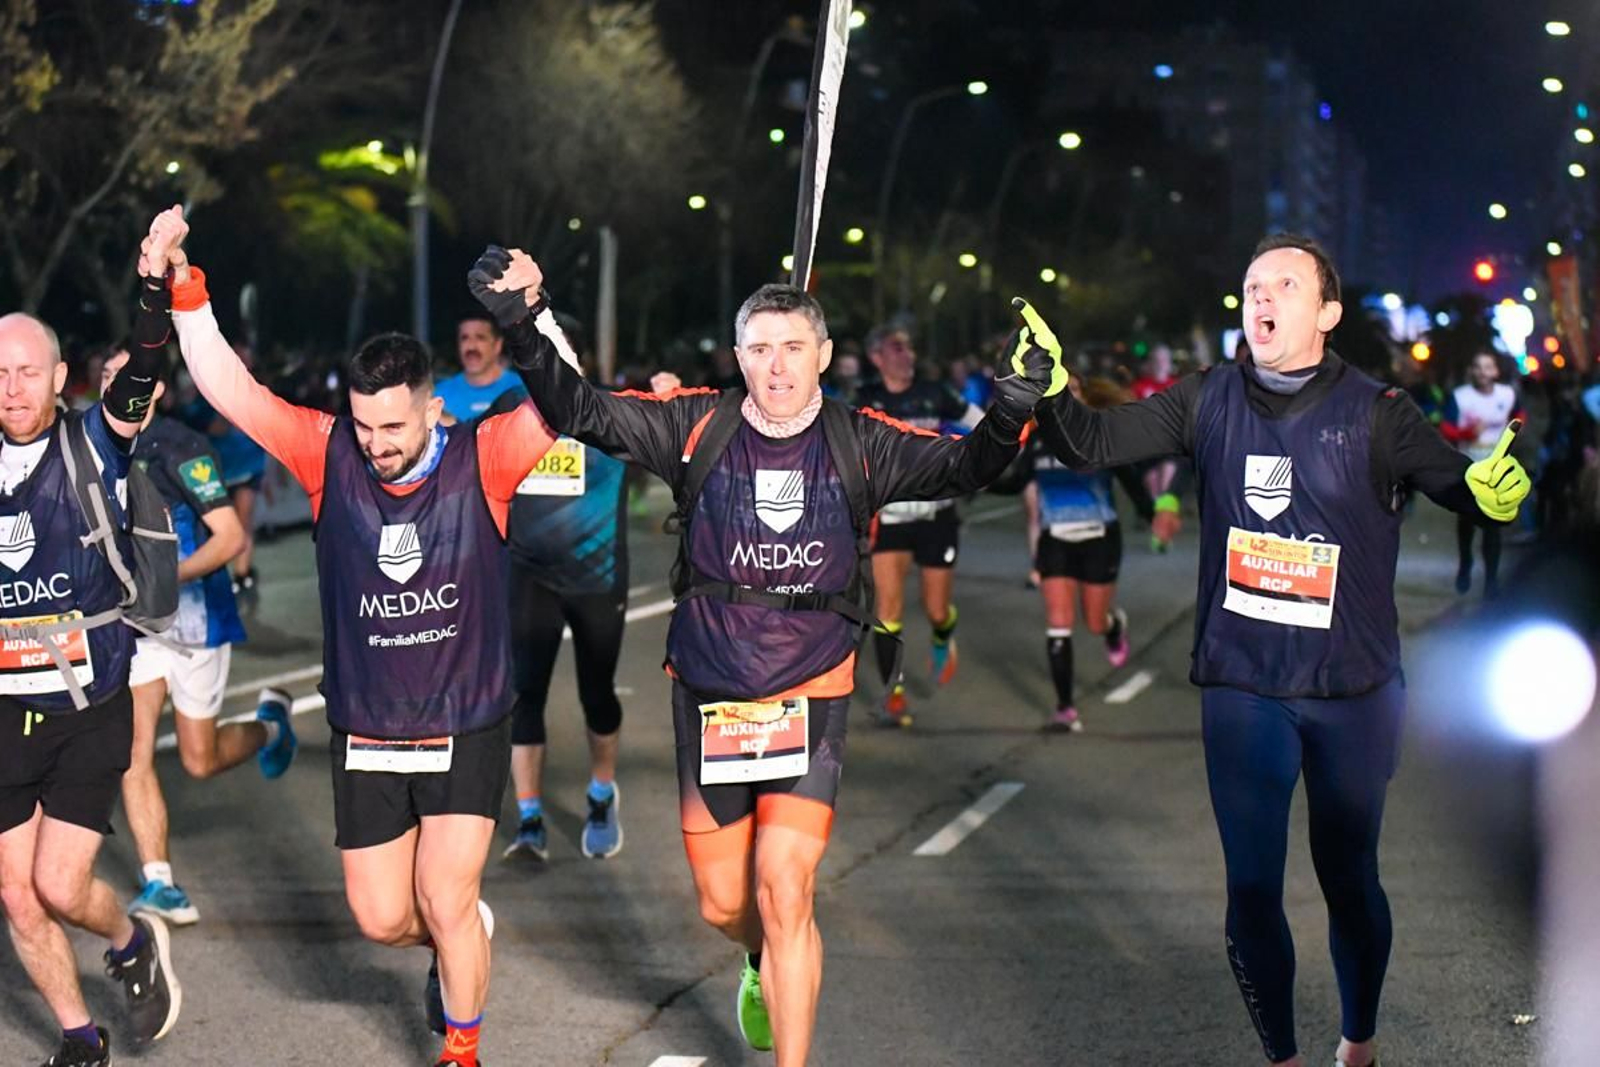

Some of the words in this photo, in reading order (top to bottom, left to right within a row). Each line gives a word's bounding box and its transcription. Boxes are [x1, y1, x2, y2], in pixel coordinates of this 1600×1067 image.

[730, 540, 825, 570] MEDAC
[1240, 554, 1319, 579] AUXILIAR
[0, 572, 72, 609] EDAC
[1259, 575, 1294, 593] RCP
[359, 583, 460, 618] MEDAC
[3, 633, 69, 651] AUXILR
[368, 624, 458, 647] #FamiliaMEDAC
[20, 652, 51, 668] RCP
